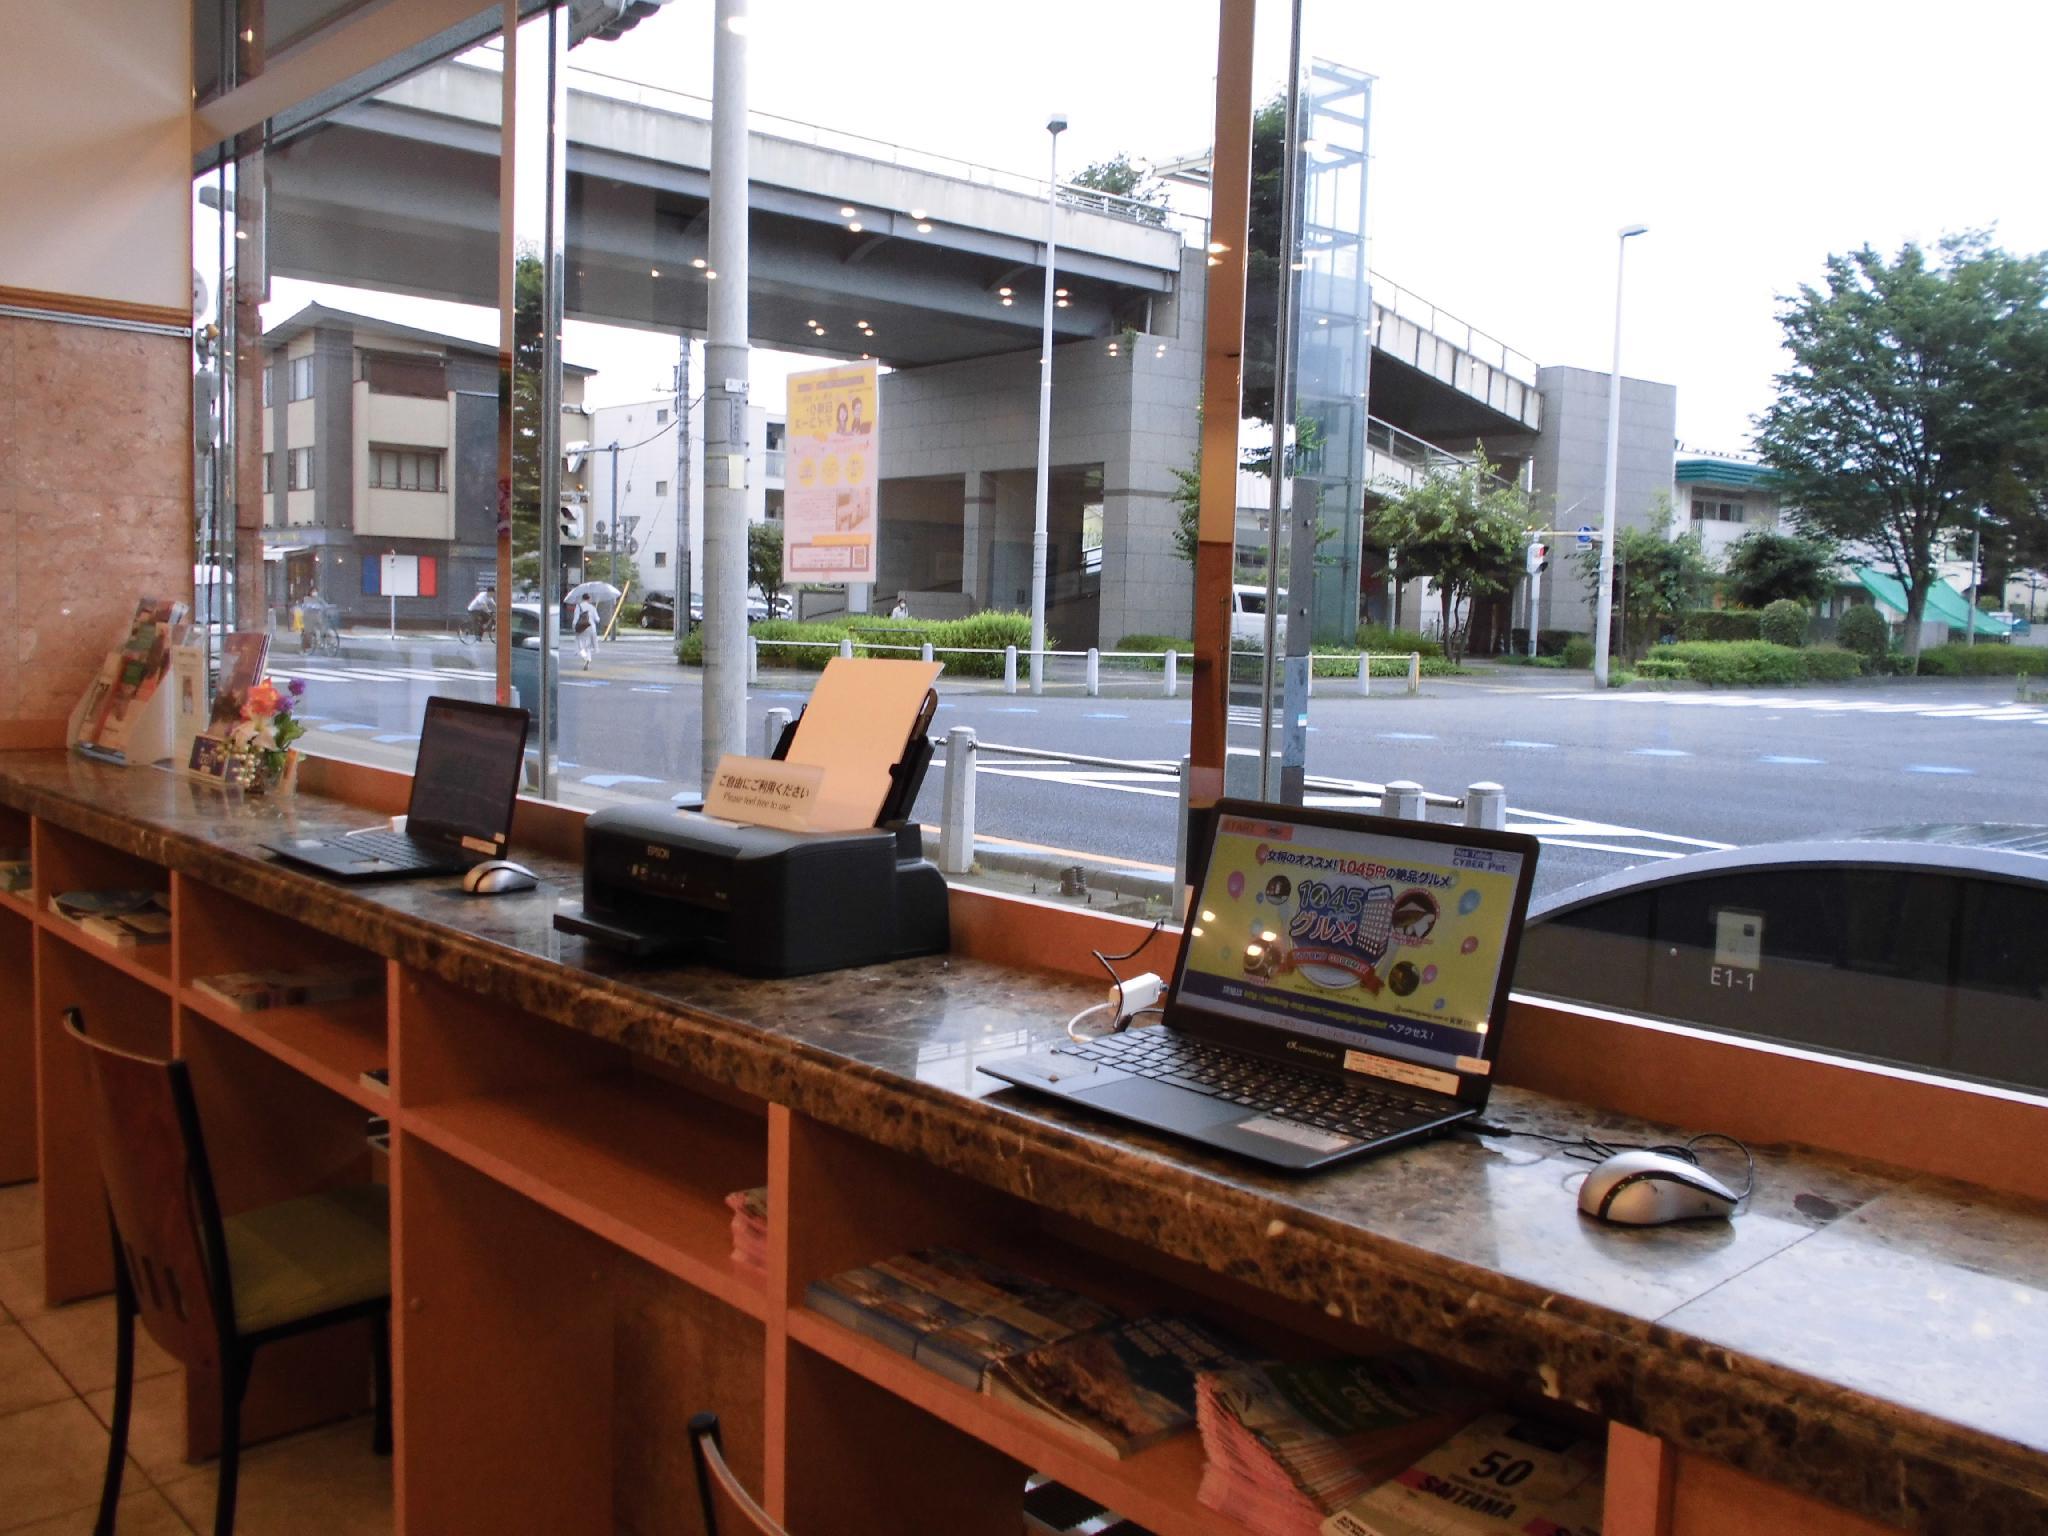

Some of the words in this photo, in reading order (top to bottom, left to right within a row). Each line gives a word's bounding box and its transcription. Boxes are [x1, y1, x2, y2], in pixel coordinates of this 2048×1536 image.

[719, 775, 810, 799] ご自由にご利用ください
[722, 792, 743, 804] Please
[1710, 966, 1755, 993] E1-1
[1468, 1450, 1535, 1488] 50
[1418, 1475, 1516, 1519] SAITAMA
